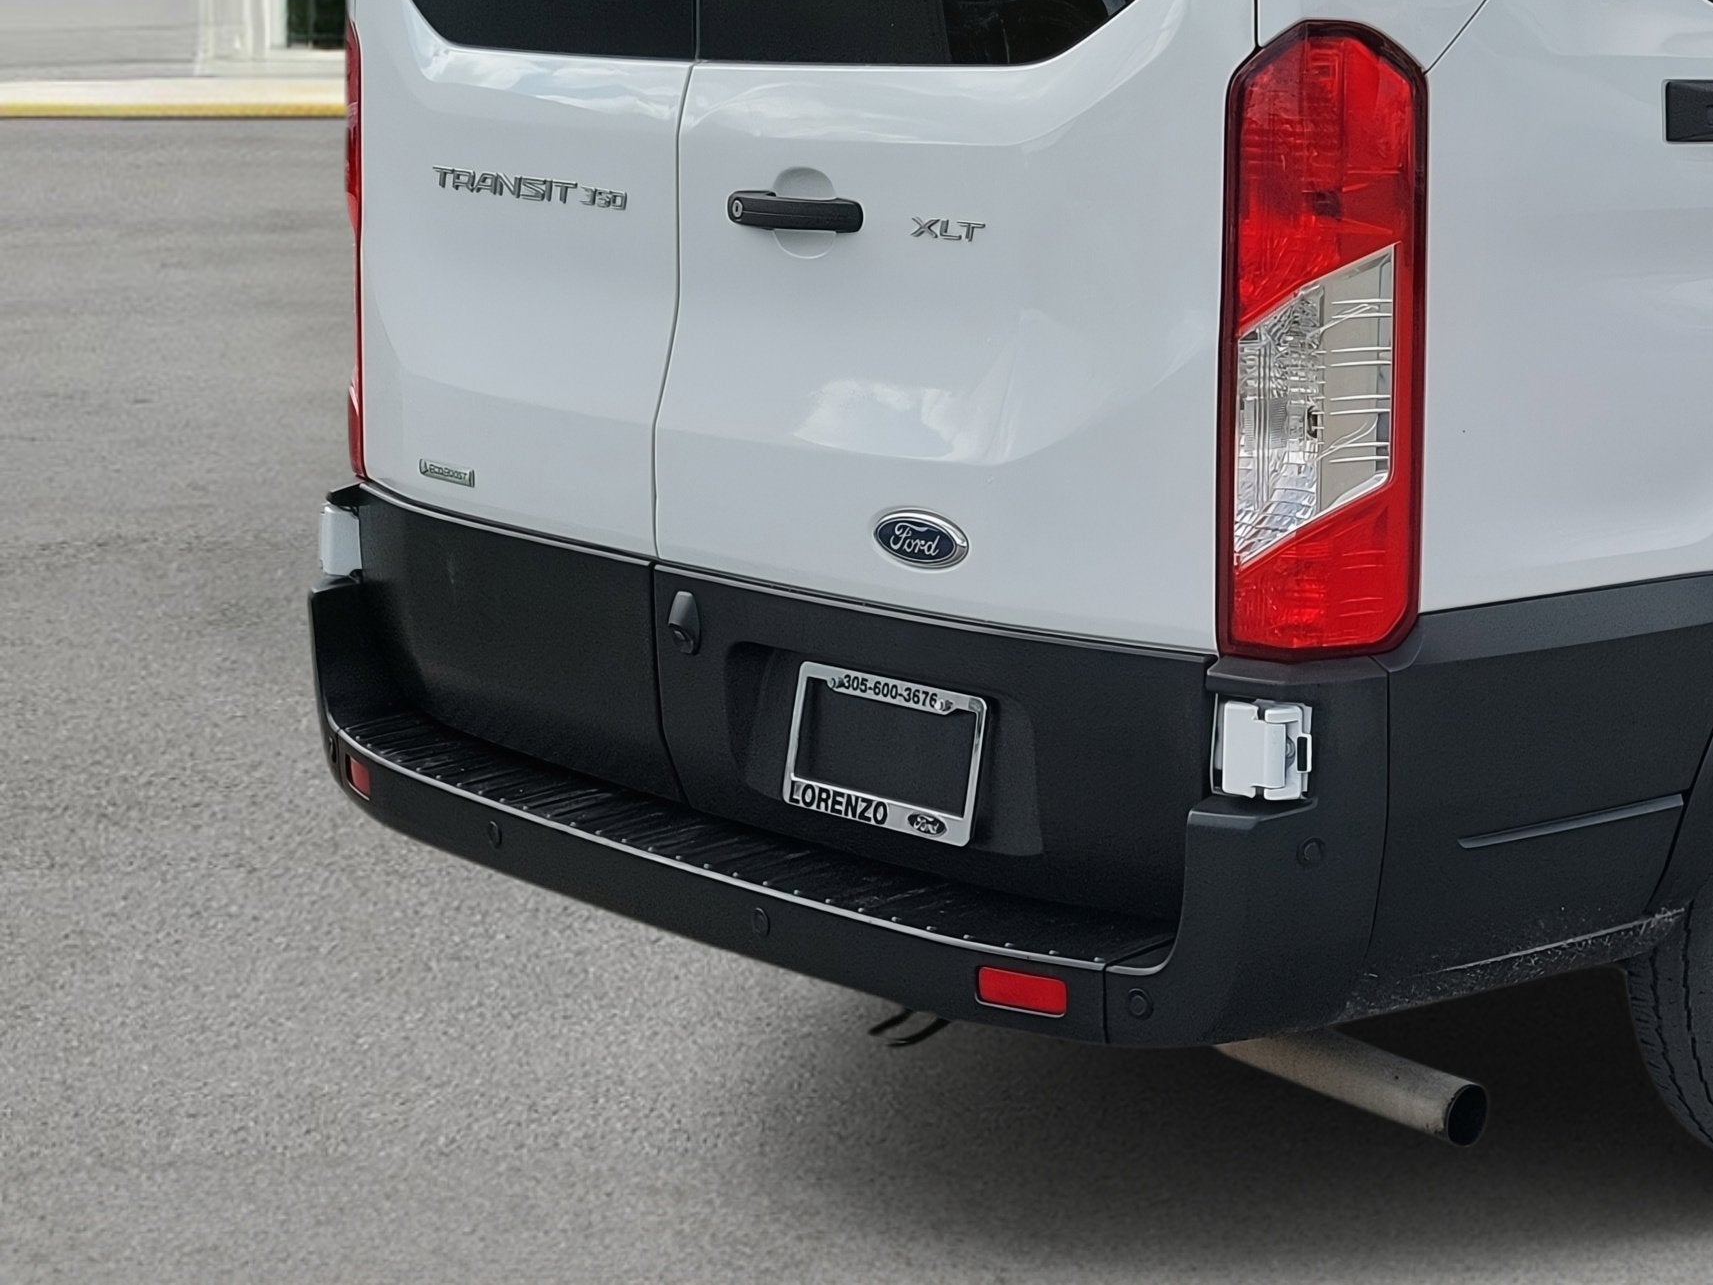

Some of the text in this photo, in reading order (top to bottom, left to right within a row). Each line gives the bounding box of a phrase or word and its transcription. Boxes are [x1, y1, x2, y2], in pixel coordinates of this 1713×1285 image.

[432, 165, 627, 211] TRANSIT 350
[910, 216, 986, 242] XLT
[889, 522, 941, 556] Ford
[842, 674, 938, 708] 305-600-3676
[788, 780, 940, 834] LORENZO Ford
